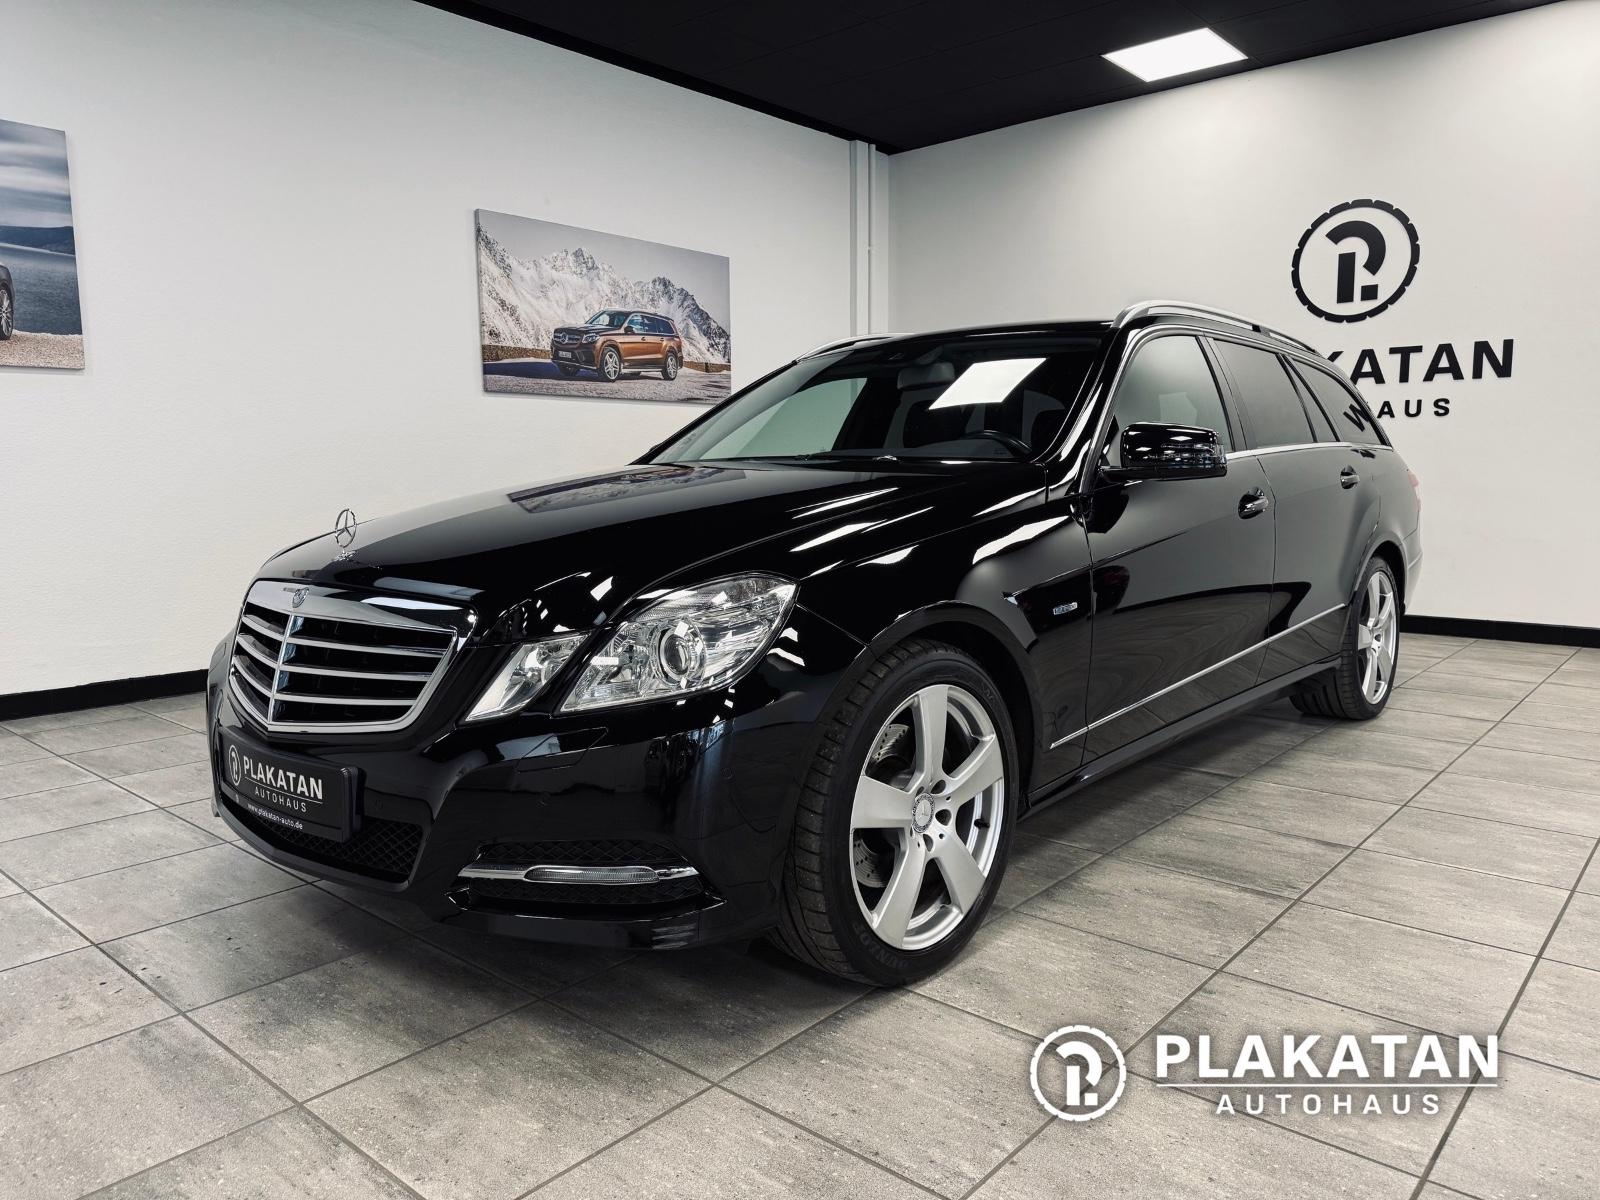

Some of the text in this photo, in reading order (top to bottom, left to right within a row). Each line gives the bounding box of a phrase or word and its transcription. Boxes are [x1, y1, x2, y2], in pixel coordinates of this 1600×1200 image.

[1327, 339, 1514, 385] ATAN
[243, 755, 323, 800] PLAKATAN
[247, 803, 303, 830] www.plakatan-auto.de
[254, 786, 307, 813] AUTOHAUS
